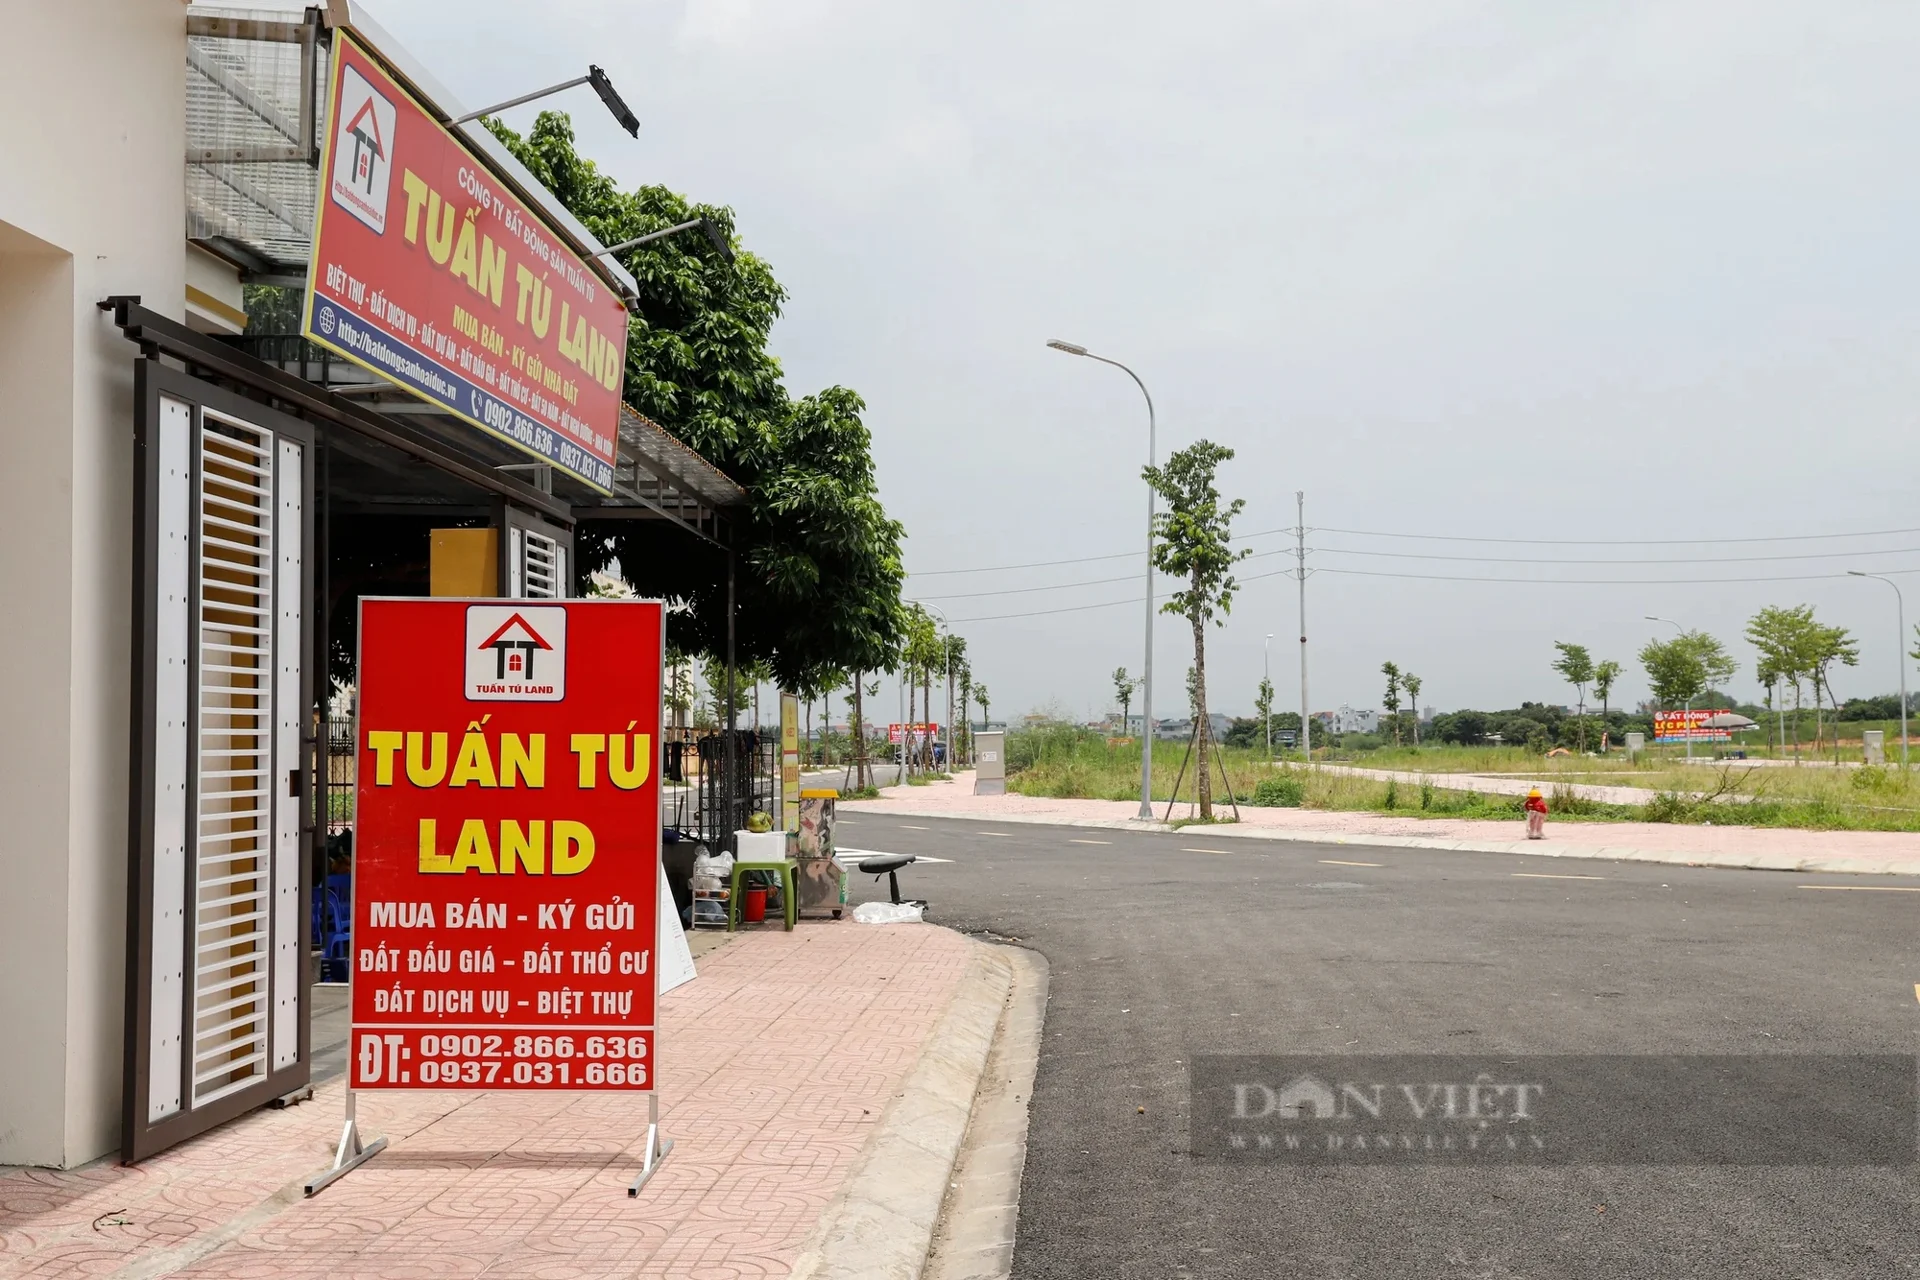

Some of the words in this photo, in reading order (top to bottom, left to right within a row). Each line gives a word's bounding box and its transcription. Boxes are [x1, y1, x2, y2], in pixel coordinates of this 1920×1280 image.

[458, 166, 491, 209] CÔNG
[493, 196, 505, 221] TY
[505, 208, 523, 238] BẤT
[523, 225, 549, 261] ĐỘNG
[550, 248, 565, 278] SẢN
[567, 265, 585, 297] TUẤN
[586, 282, 595, 303] TÚ
[403, 167, 507, 308] TUẤN
[516, 262, 552, 339] TÚ
[558, 300, 619, 391] LAND
[326, 262, 347, 297] BIỆT
[348, 276, 366, 310] THỰ
[370, 289, 387, 319] ĐẤT
[387, 300, 406, 331] DỊCH
[406, 313, 417, 342] VỤ
[421, 321, 436, 349] ĐẤT
[436, 332, 446, 360] DỰ
[446, 335, 456, 362] ÁN
[460, 345, 473, 372] ĐẤT
[472, 353, 486, 380] ĐẤU
[485, 360, 496, 386] GIÁ
[499, 369, 511, 394] ĐẤT
[338, 318, 457, 401] http://batdongsanhoaiduc.vn
[452, 304, 478, 342] MUA
[481, 324, 504, 358] BÁN
[512, 345, 526, 371] KÝ
[526, 353, 543, 383] GỬI
[543, 366, 562, 397] NHÀ
[563, 379, 579, 406] ĐẤT
[484, 398, 553, 456] 0902.866.636
[560, 441, 612, 489] 0937.031.666
[476, 683, 506, 694] TUẤN
[508, 683, 523, 694] TÚ
[525, 685, 554, 694] LAND
[368, 714, 546, 789] TUẤN
[570, 720, 651, 790] TÚ
[418, 818, 596, 875] LAND
[370, 902, 436, 929] MUA
[445, 897, 507, 929] BÁN
[538, 898, 576, 930] KÝ
[585, 895, 635, 930] GỬI
[360, 941, 400, 973] ĐẤT
[407, 941, 451, 973] ĐẤU
[459, 945, 495, 973] GIÁ
[523, 942, 564, 974] ĐẤT
[571, 942, 612, 974] THỔ
[619, 949, 649, 975] CƯ
[374, 981, 415, 1013] ĐẤT
[422, 989, 474, 1018] DỊCH
[481, 990, 510, 1018] VỤ
[537, 987, 584, 1019] BIỆT
[591, 989, 633, 1019] THỰ
[359, 1034, 411, 1084] ĐT:
[419, 1034, 647, 1059] 0902.866.636
[419, 1060, 647, 1085] 0937.031.666
